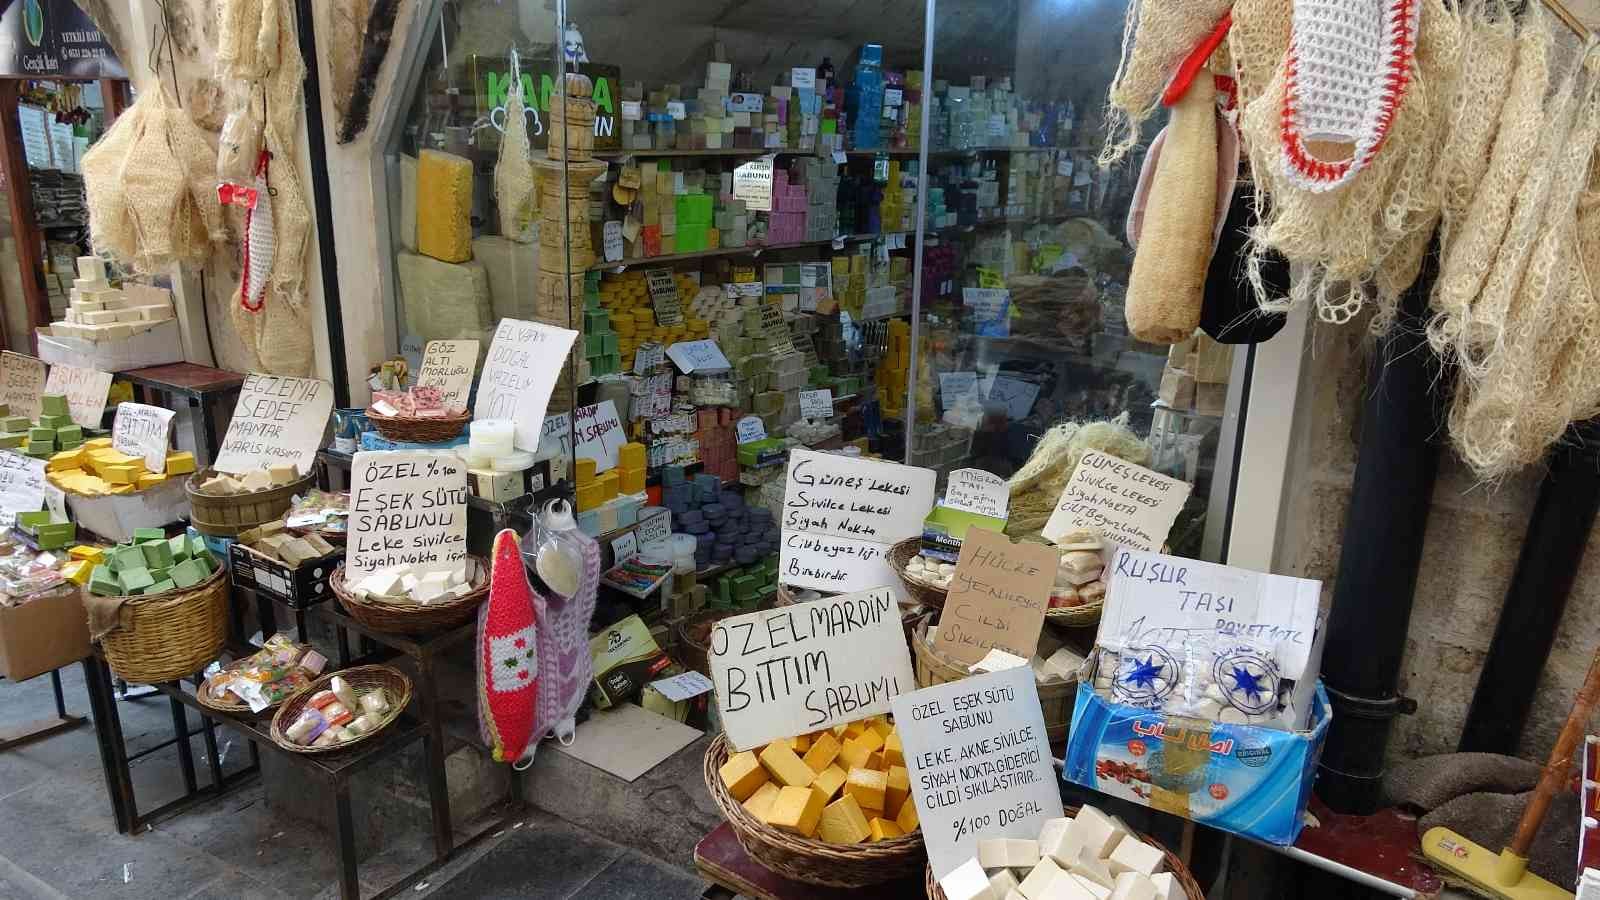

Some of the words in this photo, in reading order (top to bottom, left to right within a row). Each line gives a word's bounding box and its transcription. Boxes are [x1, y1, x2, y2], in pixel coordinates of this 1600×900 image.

[427, 341, 456, 353] GÖZ
[423, 356, 451, 366] ALTI
[242, 374, 321, 402] EGZEMA
[232, 394, 304, 421] SEDEF
[365, 461, 421, 483] ÖZEL
[355, 488, 415, 513] EŞEK
[422, 486, 467, 508] SÜTÜ
[788, 491, 845, 510] Sivilce
[356, 512, 454, 532] SABUNU
[786, 511, 828, 531] Siyah
[838, 518, 876, 535] Nokta
[358, 536, 404, 552] Leke
[354, 553, 395, 572] Siyah
[400, 550, 438, 564] Nokta
[1115, 552, 1188, 586] RUŞUR
[1179, 590, 1234, 614] TAŞI
[811, 592, 890, 639] MARDİN
[912, 700, 946, 721] ÖZEL
[953, 691, 983, 713] EŞEK
[984, 687, 1015, 704] SÜTÜ
[942, 710, 994, 734] SABUNU
[921, 767, 957, 790] SİYAH
[959, 760, 996, 781] NOKTA
[996, 745, 1041, 773] GİDERİCİ
[926, 785, 961, 809] CİLDİ
[998, 798, 1043, 828] DOĞAL
